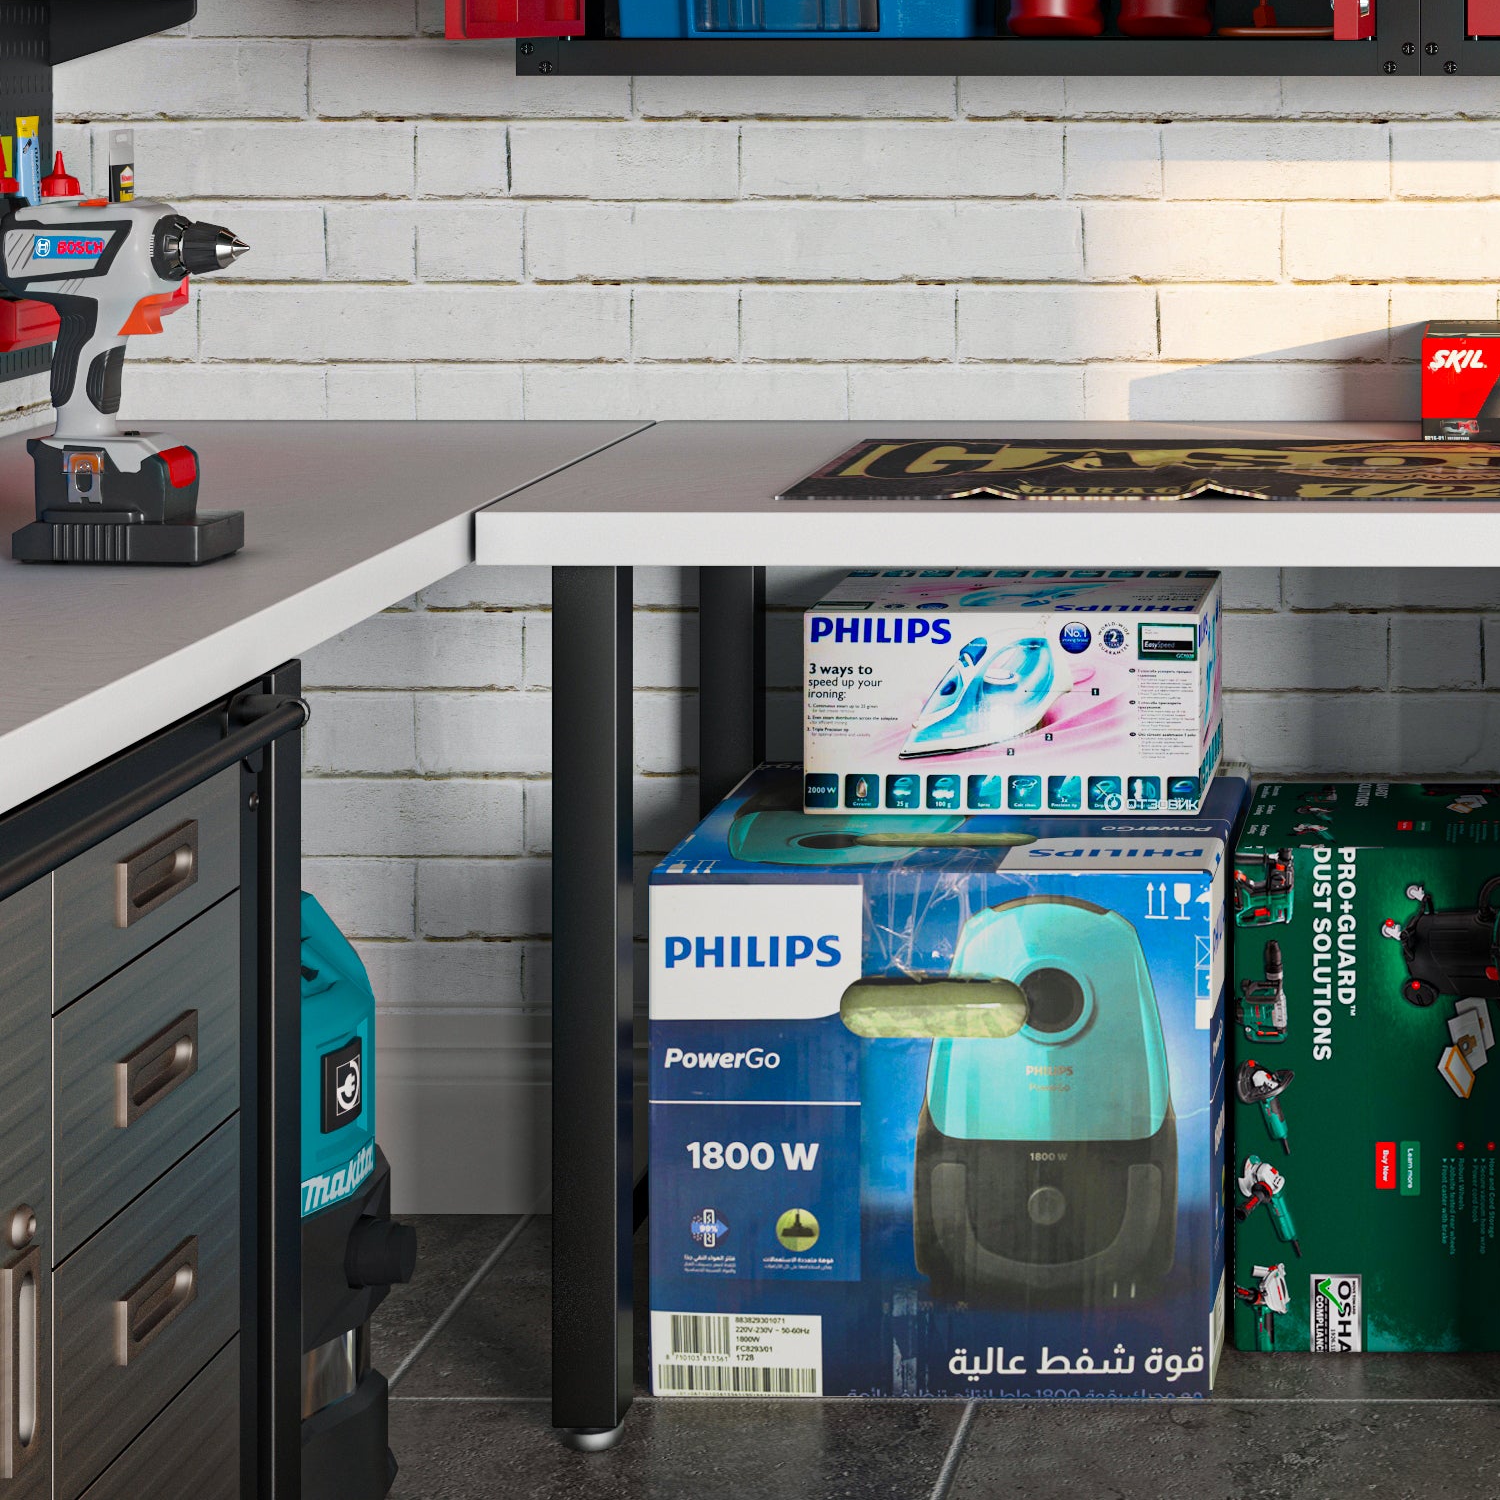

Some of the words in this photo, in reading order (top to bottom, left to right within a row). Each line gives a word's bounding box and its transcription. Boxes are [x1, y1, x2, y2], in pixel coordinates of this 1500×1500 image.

[57, 240, 103, 255] BOSCH
[1429, 350, 1483, 373] SKIL
[810, 617, 952, 645] PHILIPS
[1064, 629, 1087, 637] No.1
[1110, 631, 1117, 642] 2
[810, 663, 816, 674] 3
[820, 666, 853, 677] ways
[858, 665, 872, 674] to
[808, 677, 838, 688] speed
[842, 680, 854, 689] up
[858, 680, 882, 689] your
[808, 690, 846, 701] ironing:
[1029, 848, 1204, 857] PHILIPS
[1312, 847, 1331, 912] DUST
[664, 935, 842, 968] PHILIPS
[1312, 918, 1331, 1061] SOLUTIONS
[664, 1047, 780, 1069] PowerGo
[1025, 1065, 1073, 1076] PHILIPS
[686, 1142, 775, 1171] 1800
[785, 1142, 819, 1171] W
[1030, 1153, 1055, 1161] 1800
[1381, 1150, 1390, 1164] Buy
[1382, 1166, 1390, 1182] Now
[1337, 1281, 1352, 1352] OSHA
[949, 1346, 1027, 1382] عالية
[1036, 1343, 1135, 1375] شفط
[1145, 1346, 1204, 1382] قوة
